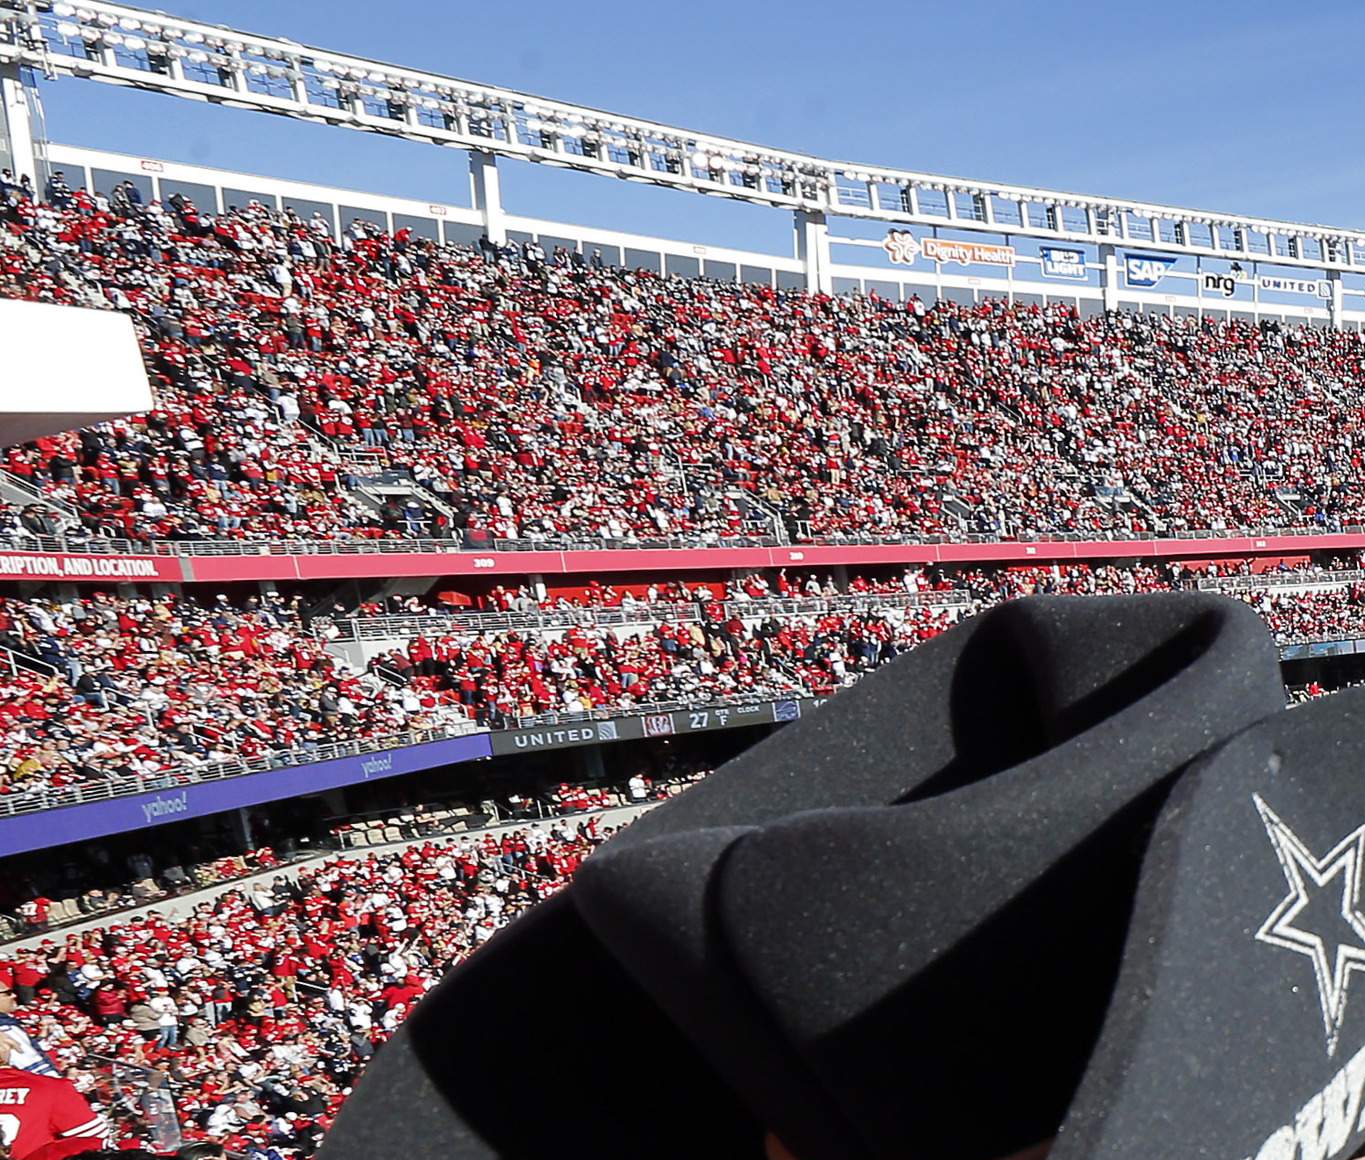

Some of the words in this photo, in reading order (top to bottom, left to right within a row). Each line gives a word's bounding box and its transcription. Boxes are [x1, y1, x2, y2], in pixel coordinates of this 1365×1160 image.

[926, 242, 973, 265] Dignity
[974, 246, 1013, 264] Health
[1046, 262, 1085, 276] LIGHT
[1128, 260, 1166, 281] SAP
[1205, 274, 1235, 296] nrg
[1261, 279, 1316, 294] UNITED
[0, 557, 63, 576] RIPTION,
[63, 558, 92, 576] AND
[92, 559, 159, 577] LOCATION.
[474, 558, 495, 567] 309
[737, 704, 760, 714] CLOCK
[689, 711, 709, 729] 27
[515, 728, 594, 748] UNITED
[360, 753, 393, 778] yahoo!
[141, 792, 188, 822] yahoo!
